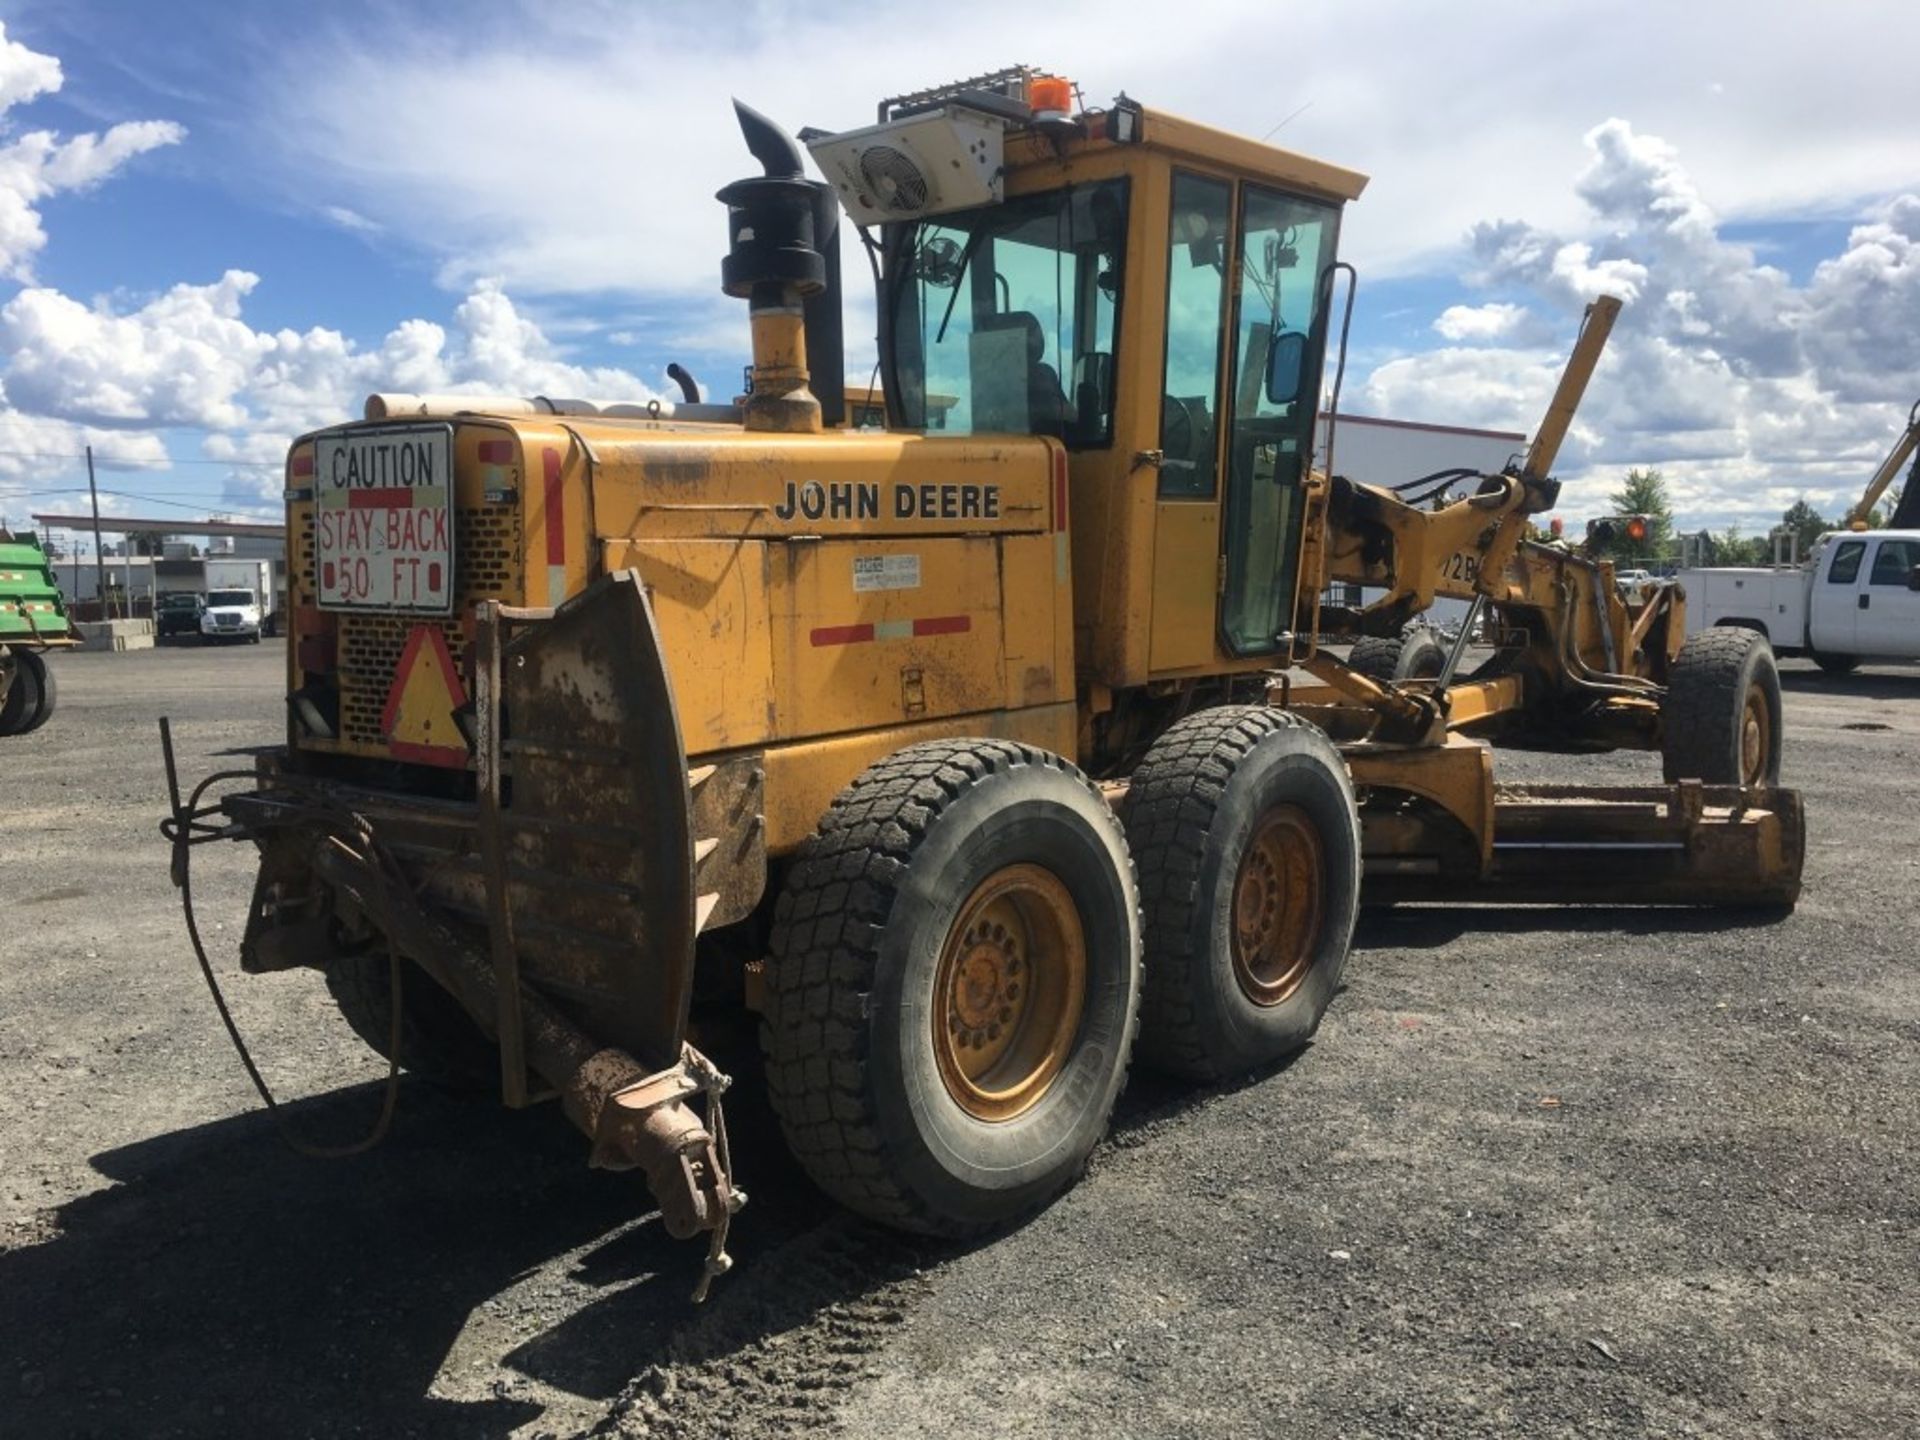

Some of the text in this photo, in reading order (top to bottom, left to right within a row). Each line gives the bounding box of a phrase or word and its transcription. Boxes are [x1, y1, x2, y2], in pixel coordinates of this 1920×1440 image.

[332, 442, 433, 488] CAUTION
[775, 481, 999, 521] JOHN DEERE
[321, 507, 448, 551] STAY BACK
[339, 557, 421, 600] 50 FT
